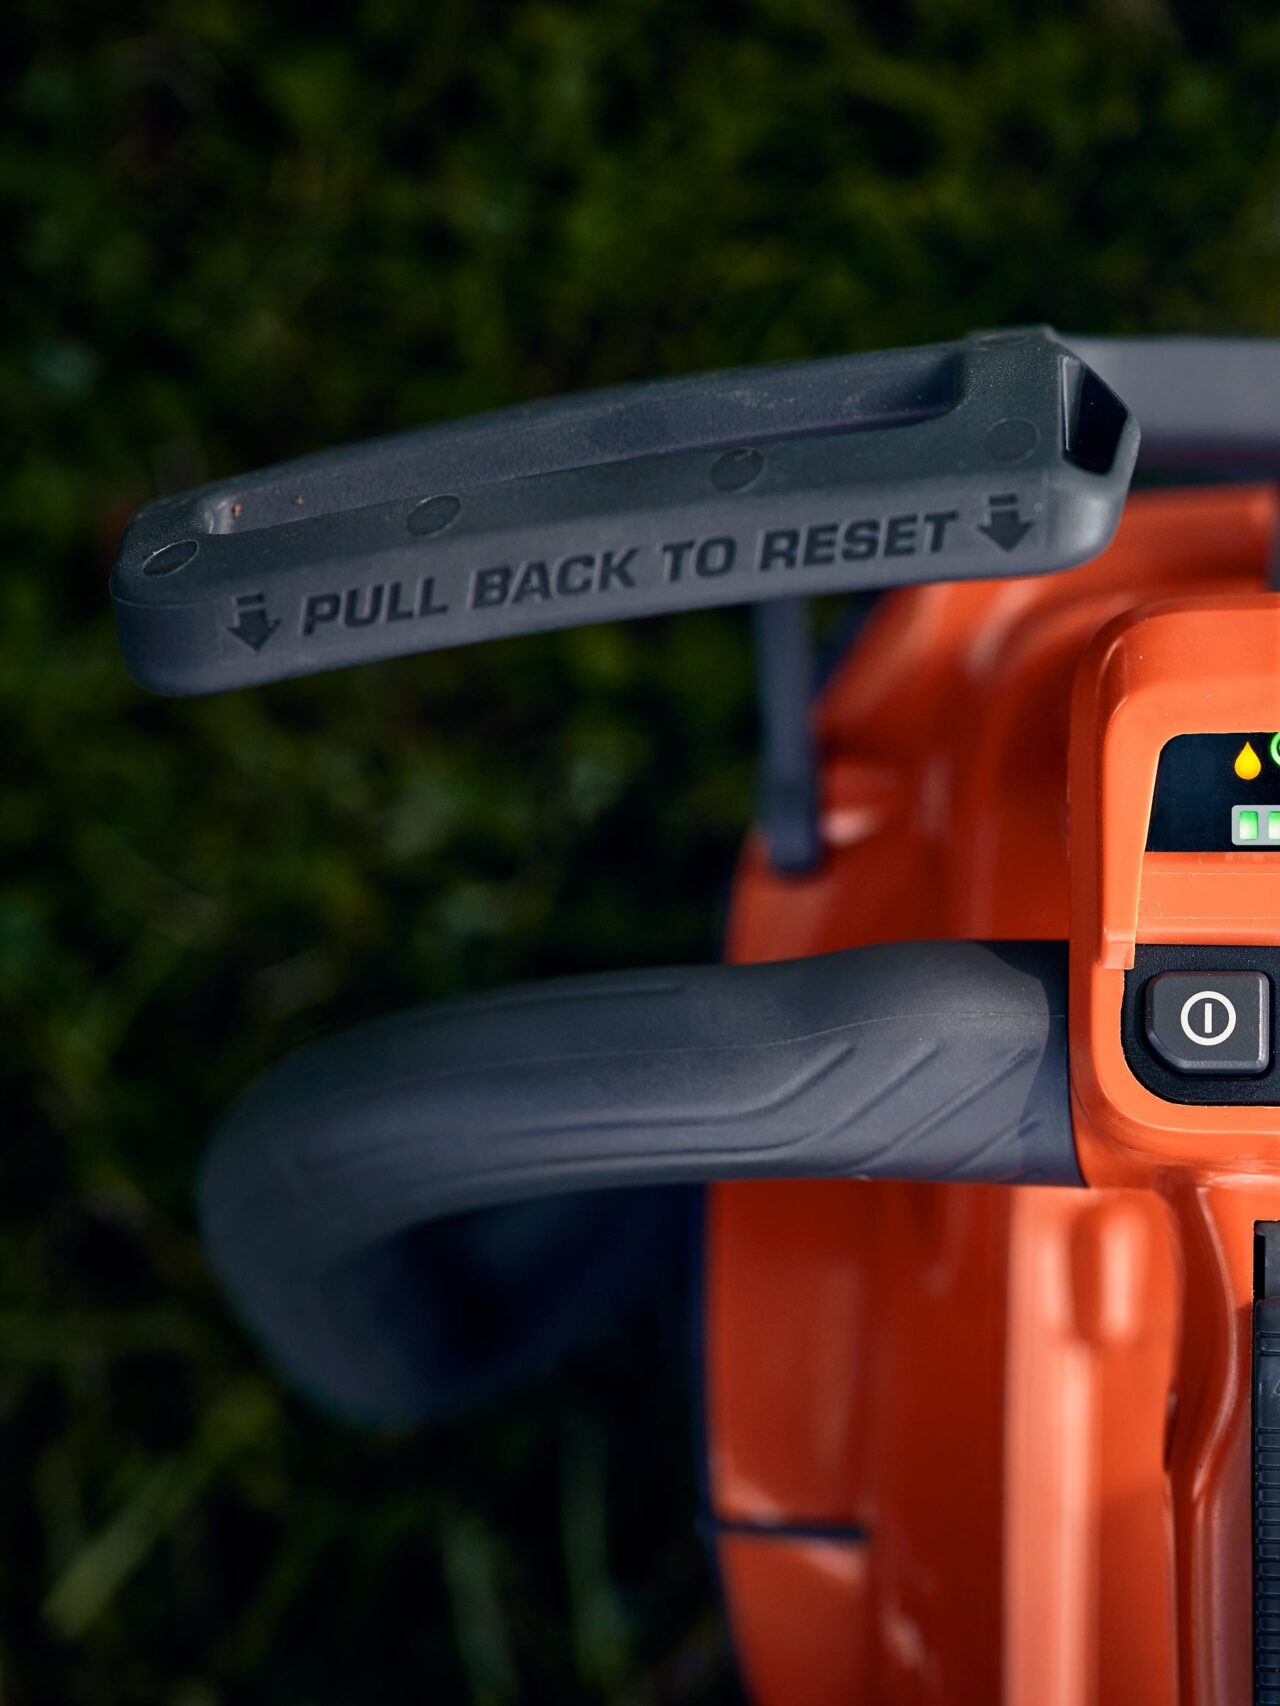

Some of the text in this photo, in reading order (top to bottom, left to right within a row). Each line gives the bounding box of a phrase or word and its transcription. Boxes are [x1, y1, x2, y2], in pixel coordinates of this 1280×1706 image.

[302, 510, 959, 636] PULL BACK TO RESET
